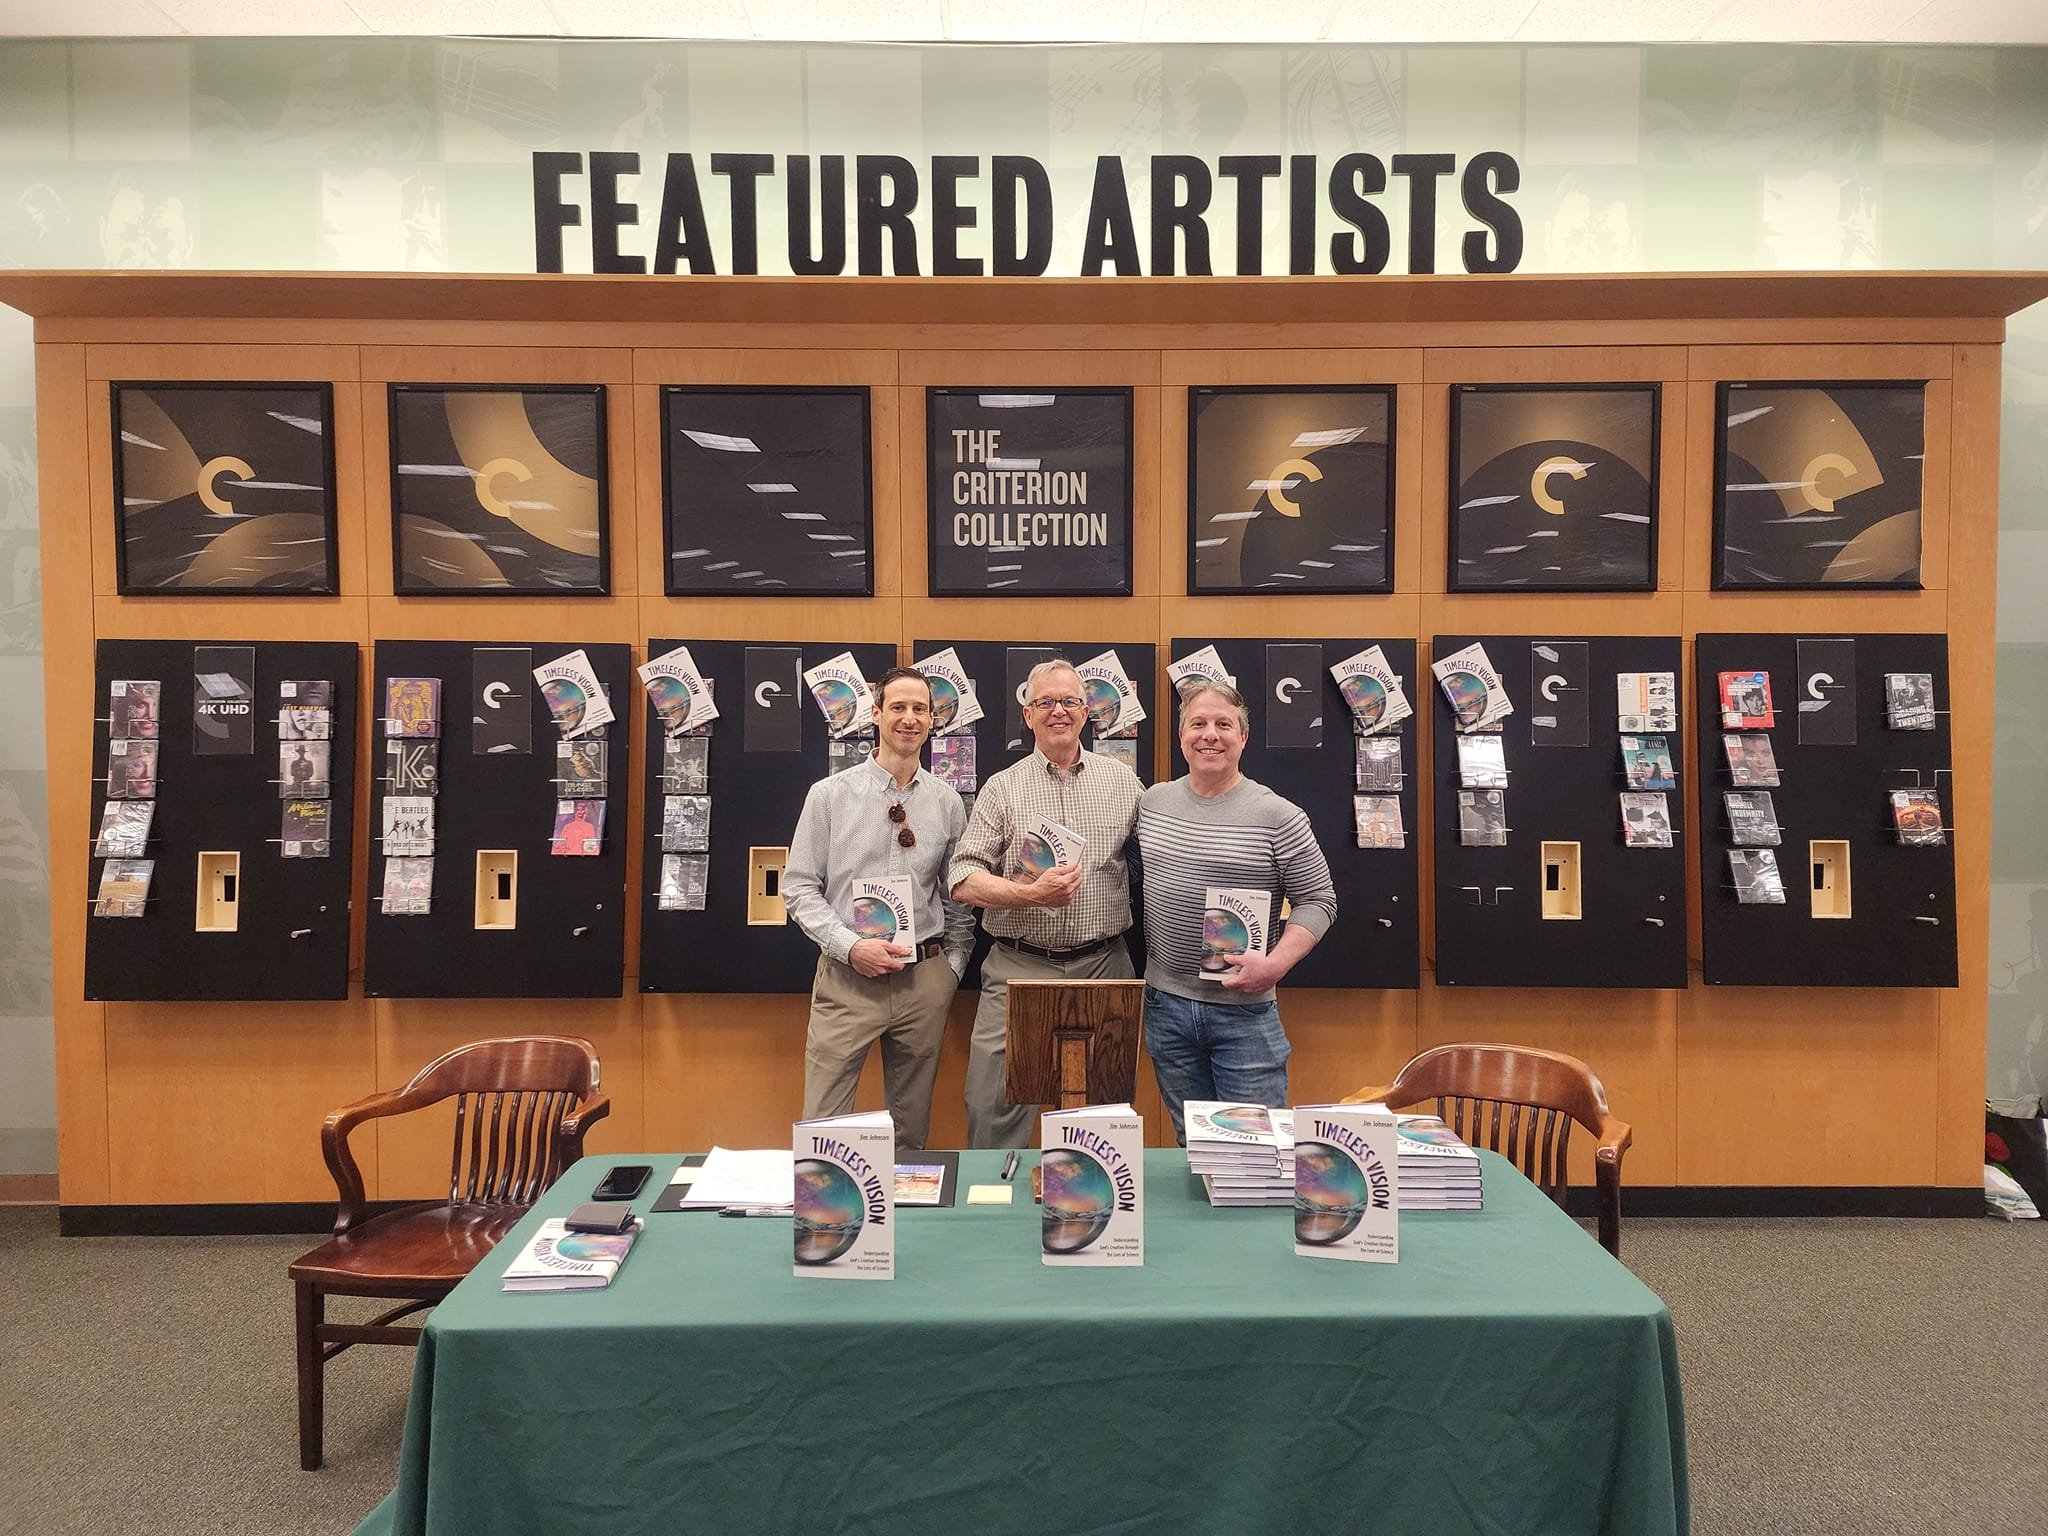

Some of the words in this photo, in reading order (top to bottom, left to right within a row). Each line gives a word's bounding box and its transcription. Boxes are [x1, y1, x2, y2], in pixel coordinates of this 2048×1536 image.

[533, 151, 1053, 276] FEATURED
[1080, 151, 1524, 276] ARTISTS
[952, 430, 1000, 463] THE
[953, 471, 1087, 505] CRITERION
[953, 512, 1107, 547] COLLECTION
[544, 667, 579, 679] TIMELESS
[579, 674, 597, 699] VISION
[648, 664, 683, 677] TIMELESS
[682, 671, 701, 696] VISION
[814, 668, 849, 681] TIMELESS
[847, 674, 867, 698] VISION
[950, 670, 969, 696] VISION
[1078, 667, 1112, 679] TIMELESS
[1111, 673, 1130, 698] VISION
[1177, 662, 1212, 675] TIMELESS
[1342, 663, 1377, 675] TIMELESS
[1377, 669, 1397, 694] VISION
[1444, 660, 1479, 673] TIMELESS
[1478, 667, 1498, 692] VISION
[198, 704, 217, 715] 4K
[220, 704, 250, 715] UHD
[1040, 824, 1067, 858] TIMELESS
[863, 883, 900, 905] TIMELESS
[894, 902, 909, 931] VISION
[1219, 894, 1256, 922] TIMELESS
[1249, 920, 1262, 951] VISION
[812, 1136, 872, 1178] TIMELESS
[863, 1175, 886, 1225] VISION
[1062, 1126, 1122, 1166] TIMELESS
[1113, 1163, 1136, 1212] VISION
[1314, 1120, 1376, 1162] TIMELESS
[1366, 1160, 1390, 1210] VISION
